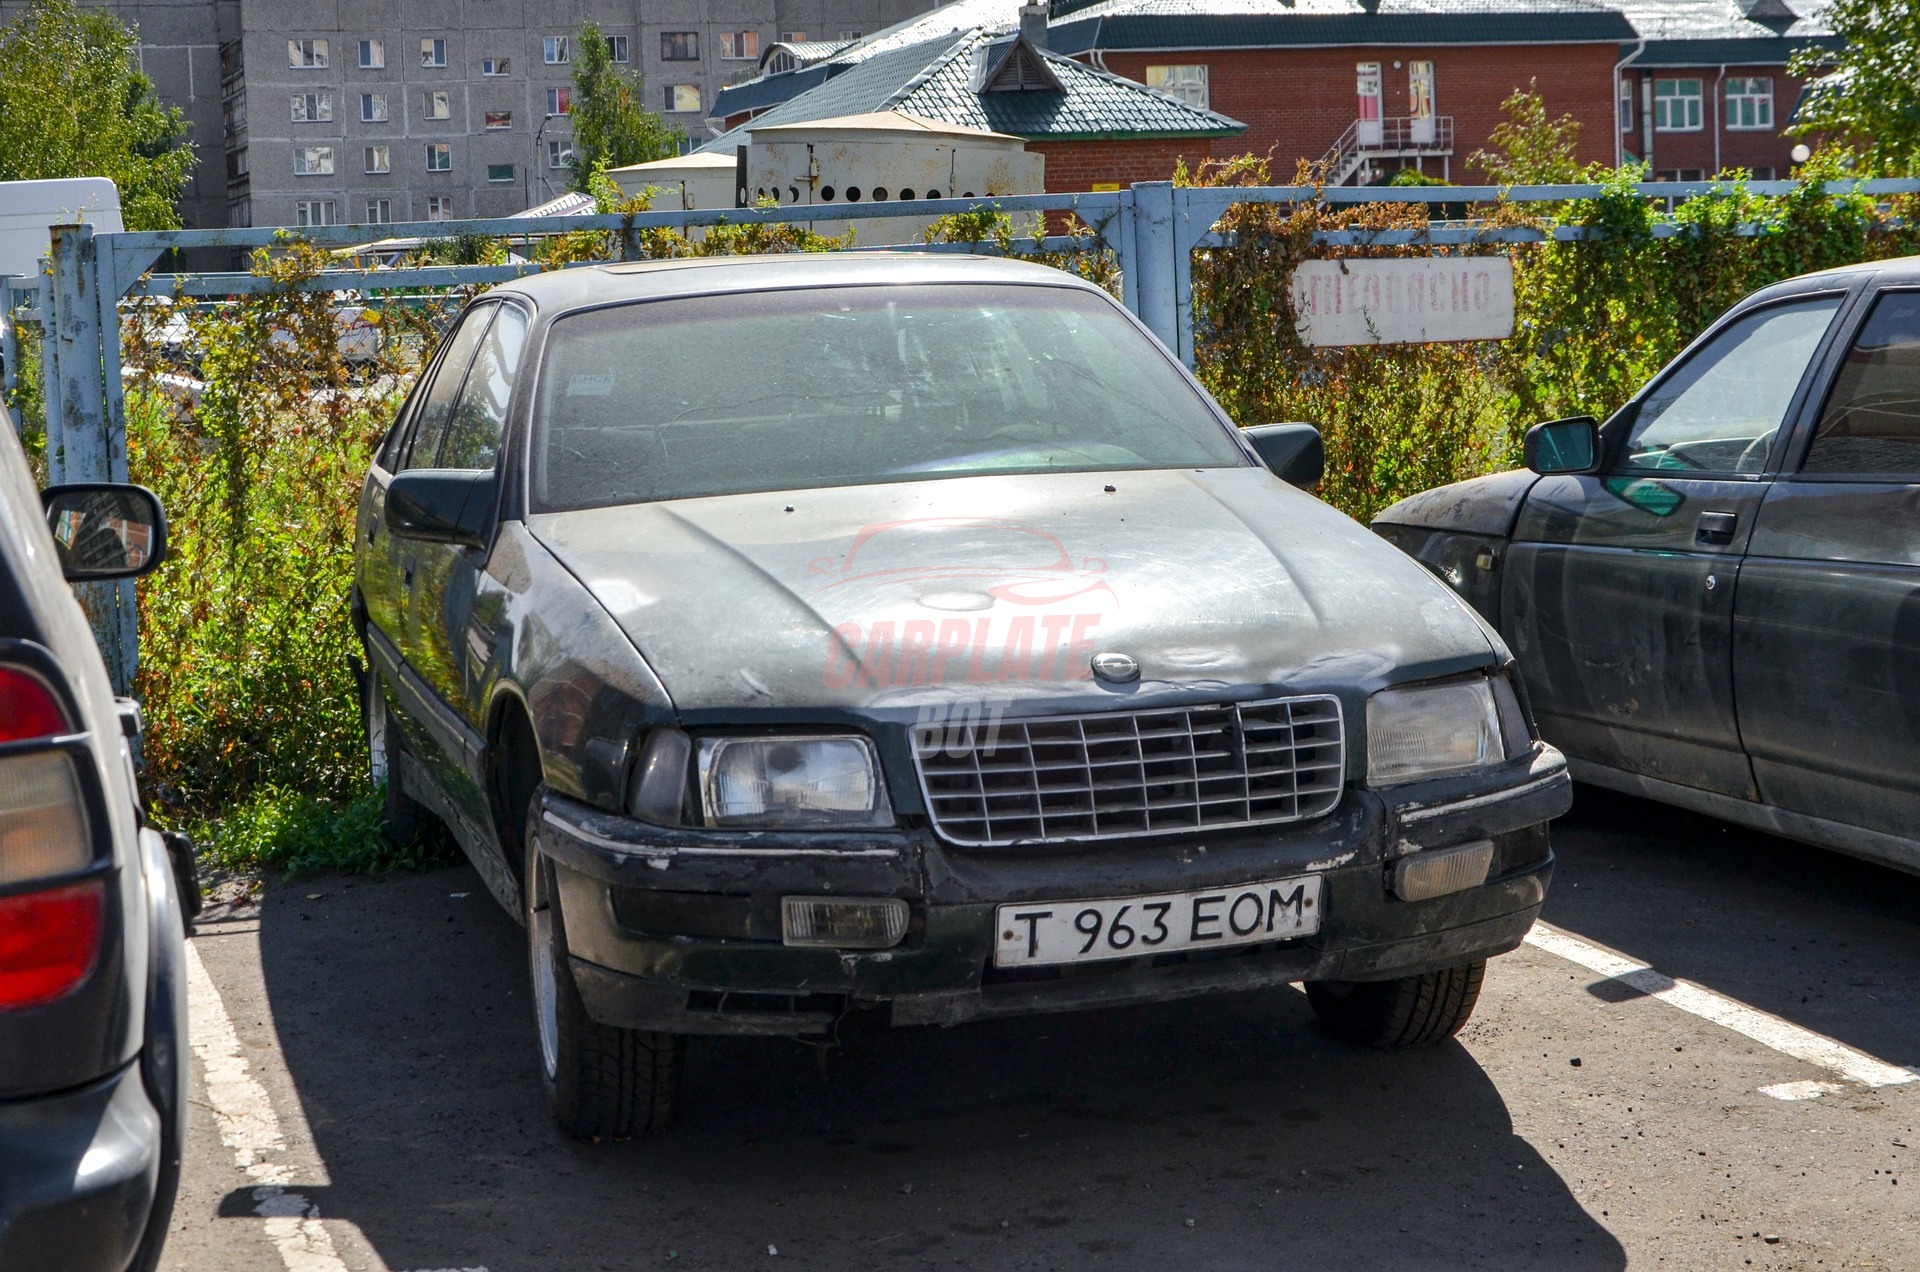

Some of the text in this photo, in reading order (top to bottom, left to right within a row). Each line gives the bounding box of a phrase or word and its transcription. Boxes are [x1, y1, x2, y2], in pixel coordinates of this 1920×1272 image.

[1014, 884, 1305, 958] T 963 EOM
